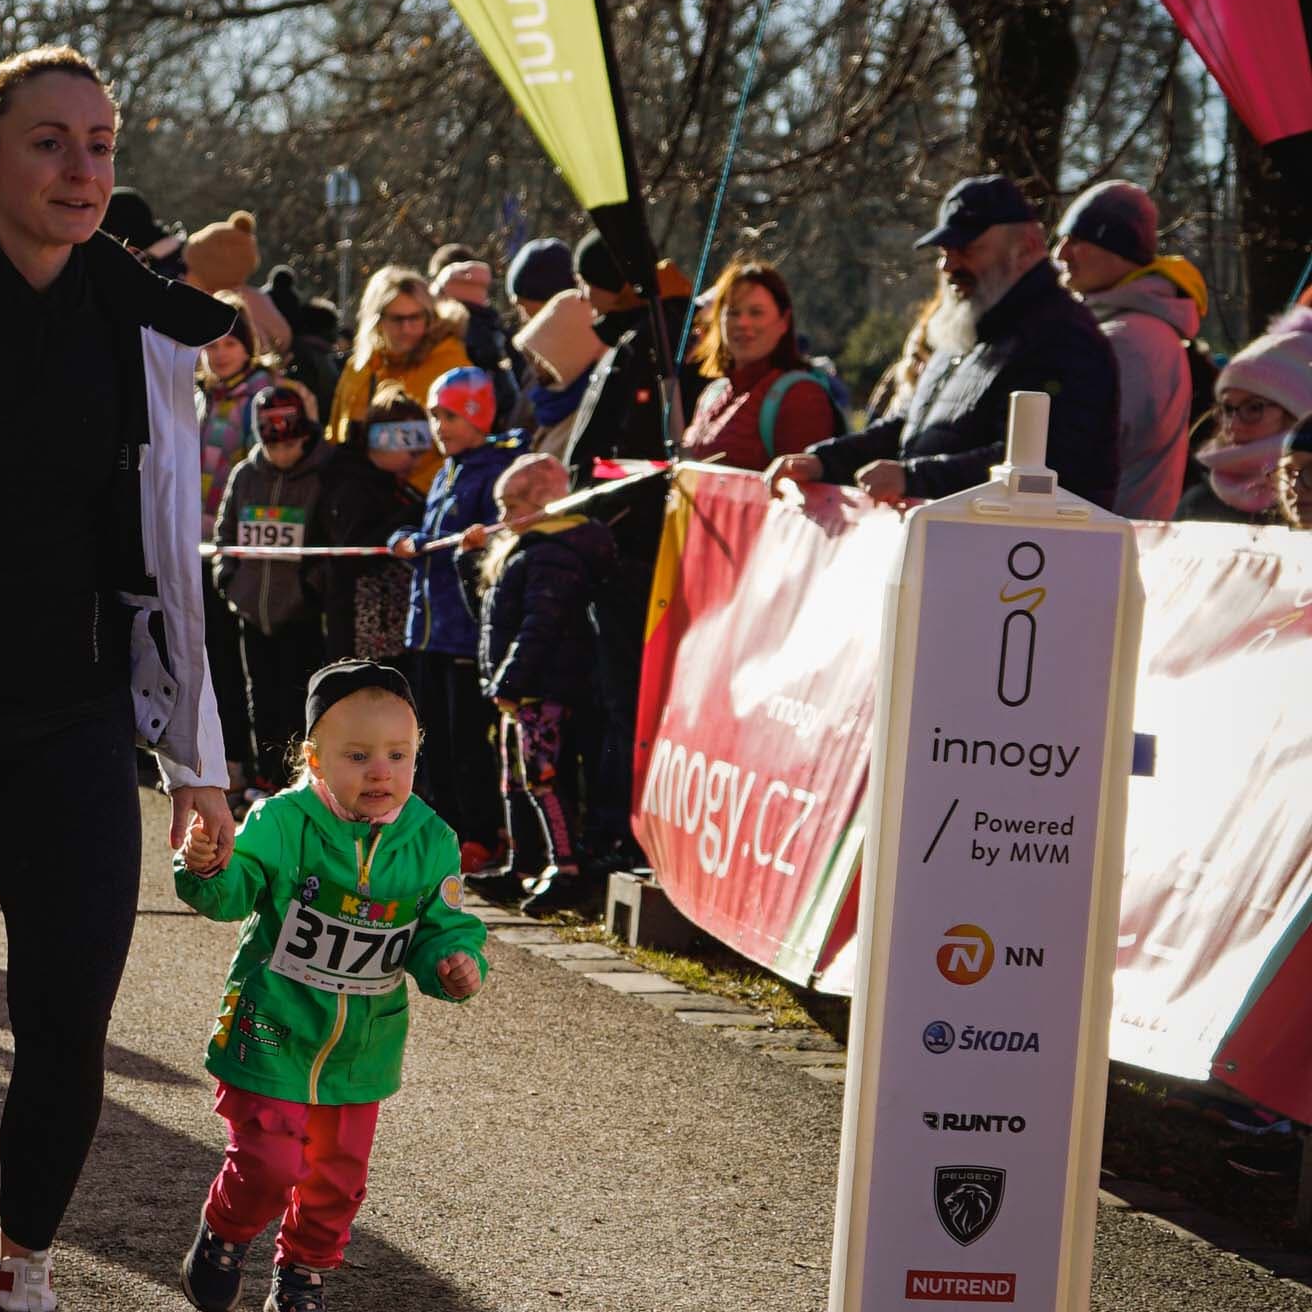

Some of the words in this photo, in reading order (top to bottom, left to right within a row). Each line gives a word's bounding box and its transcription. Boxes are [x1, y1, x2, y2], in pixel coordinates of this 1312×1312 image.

[243, 523, 294, 546] 3195
[933, 727, 1080, 777] innogy
[974, 811, 1074, 836] Powered
[971, 839, 1000, 866] by
[1010, 842, 1070, 865] MVM
[285, 908, 411, 974] 3170
[1005, 946, 1044, 967] NN
[958, 1025, 1040, 1053] ŠKODA
[942, 1112, 1026, 1133] RUNTO
[941, 1172, 999, 1183] PEUGEOT
[912, 1276, 1011, 1297] NUTREND
